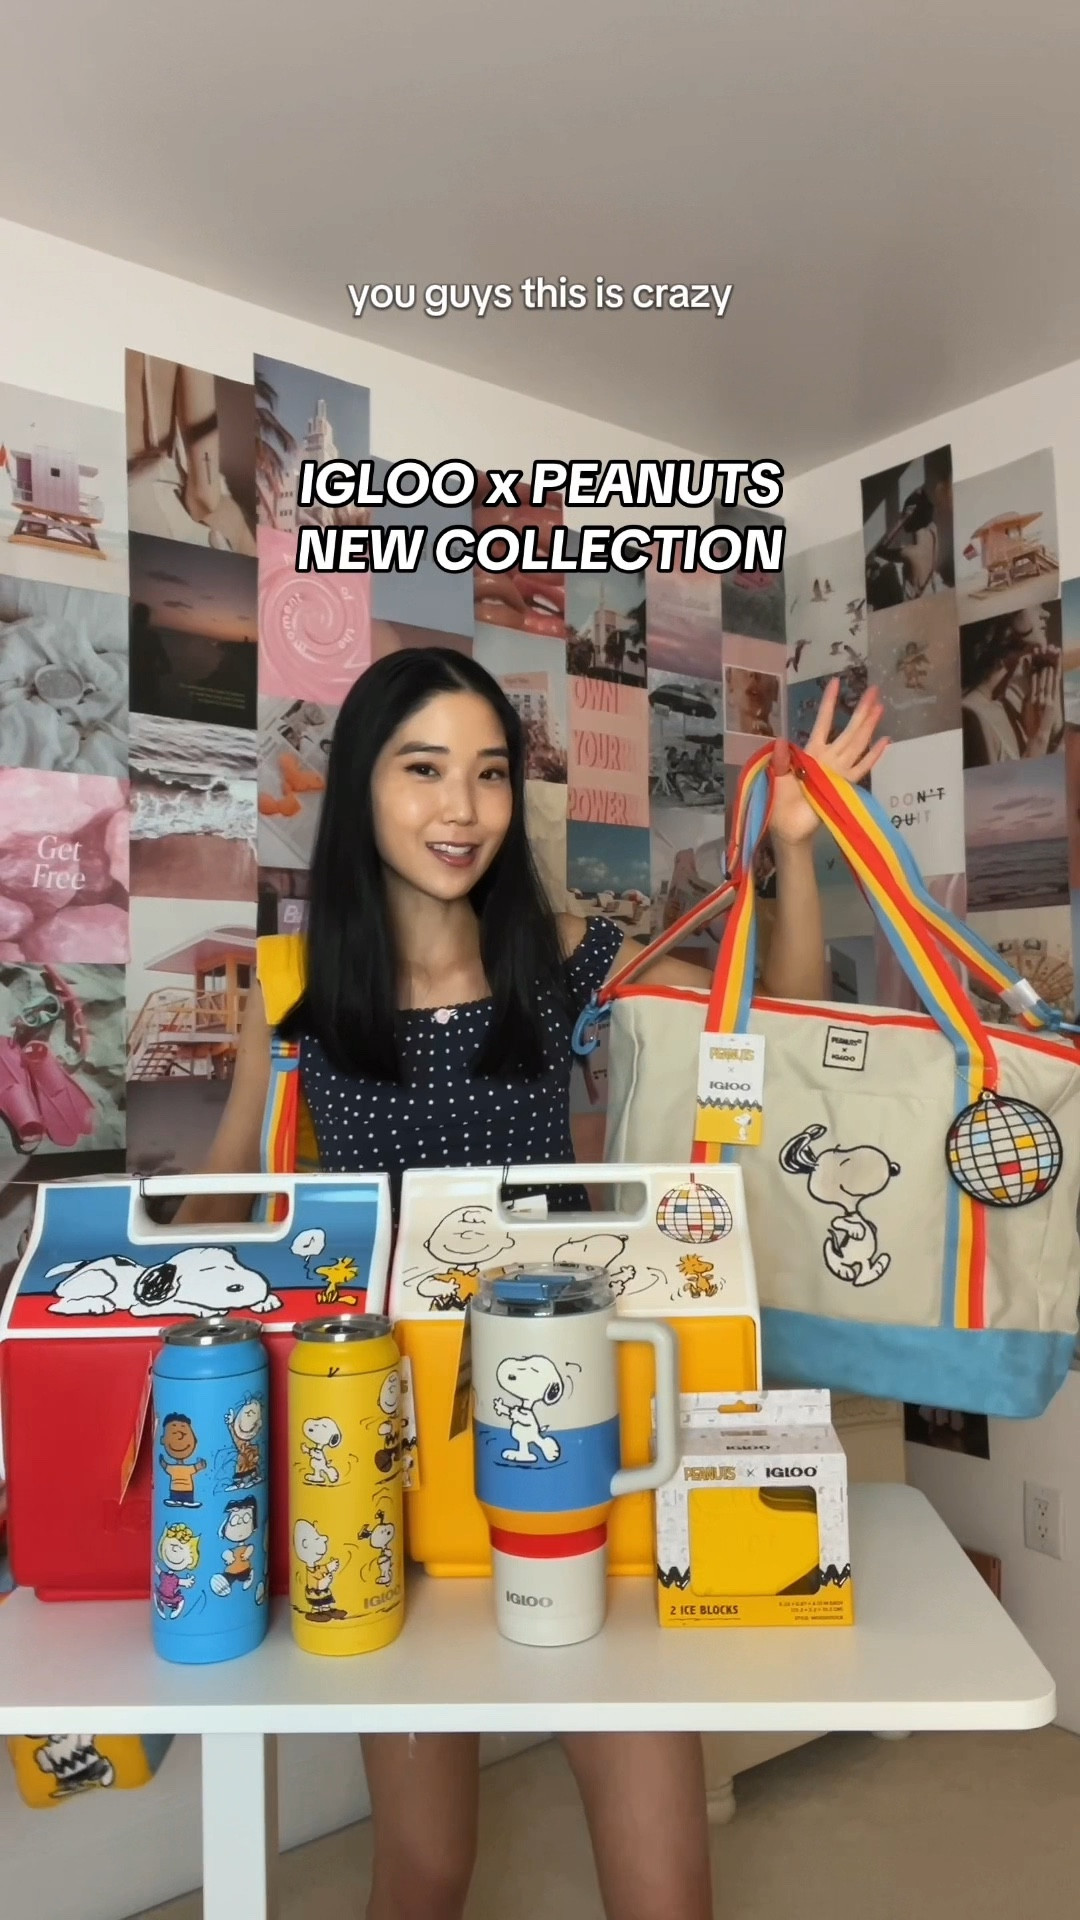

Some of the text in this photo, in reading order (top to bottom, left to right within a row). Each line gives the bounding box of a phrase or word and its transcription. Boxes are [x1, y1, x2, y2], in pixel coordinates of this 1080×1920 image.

[574, 677, 619, 714] OWN
[574, 729, 622, 770] YOUR
[569, 787, 628, 824] POWER
[890, 787, 946, 808] DON'T
[891, 810, 930, 829] QUIT
[37, 835, 83, 861] Get
[32, 863, 86, 890] Free
[709, 1081, 751, 1092] IGLOO
[684, 1466, 737, 1481] PEANUTS
[765, 1467, 817, 1479] IGLOO
[506, 1590, 554, 1608] IGLOO
[670, 1605, 739, 1615] 2 ICE BLOCKS
